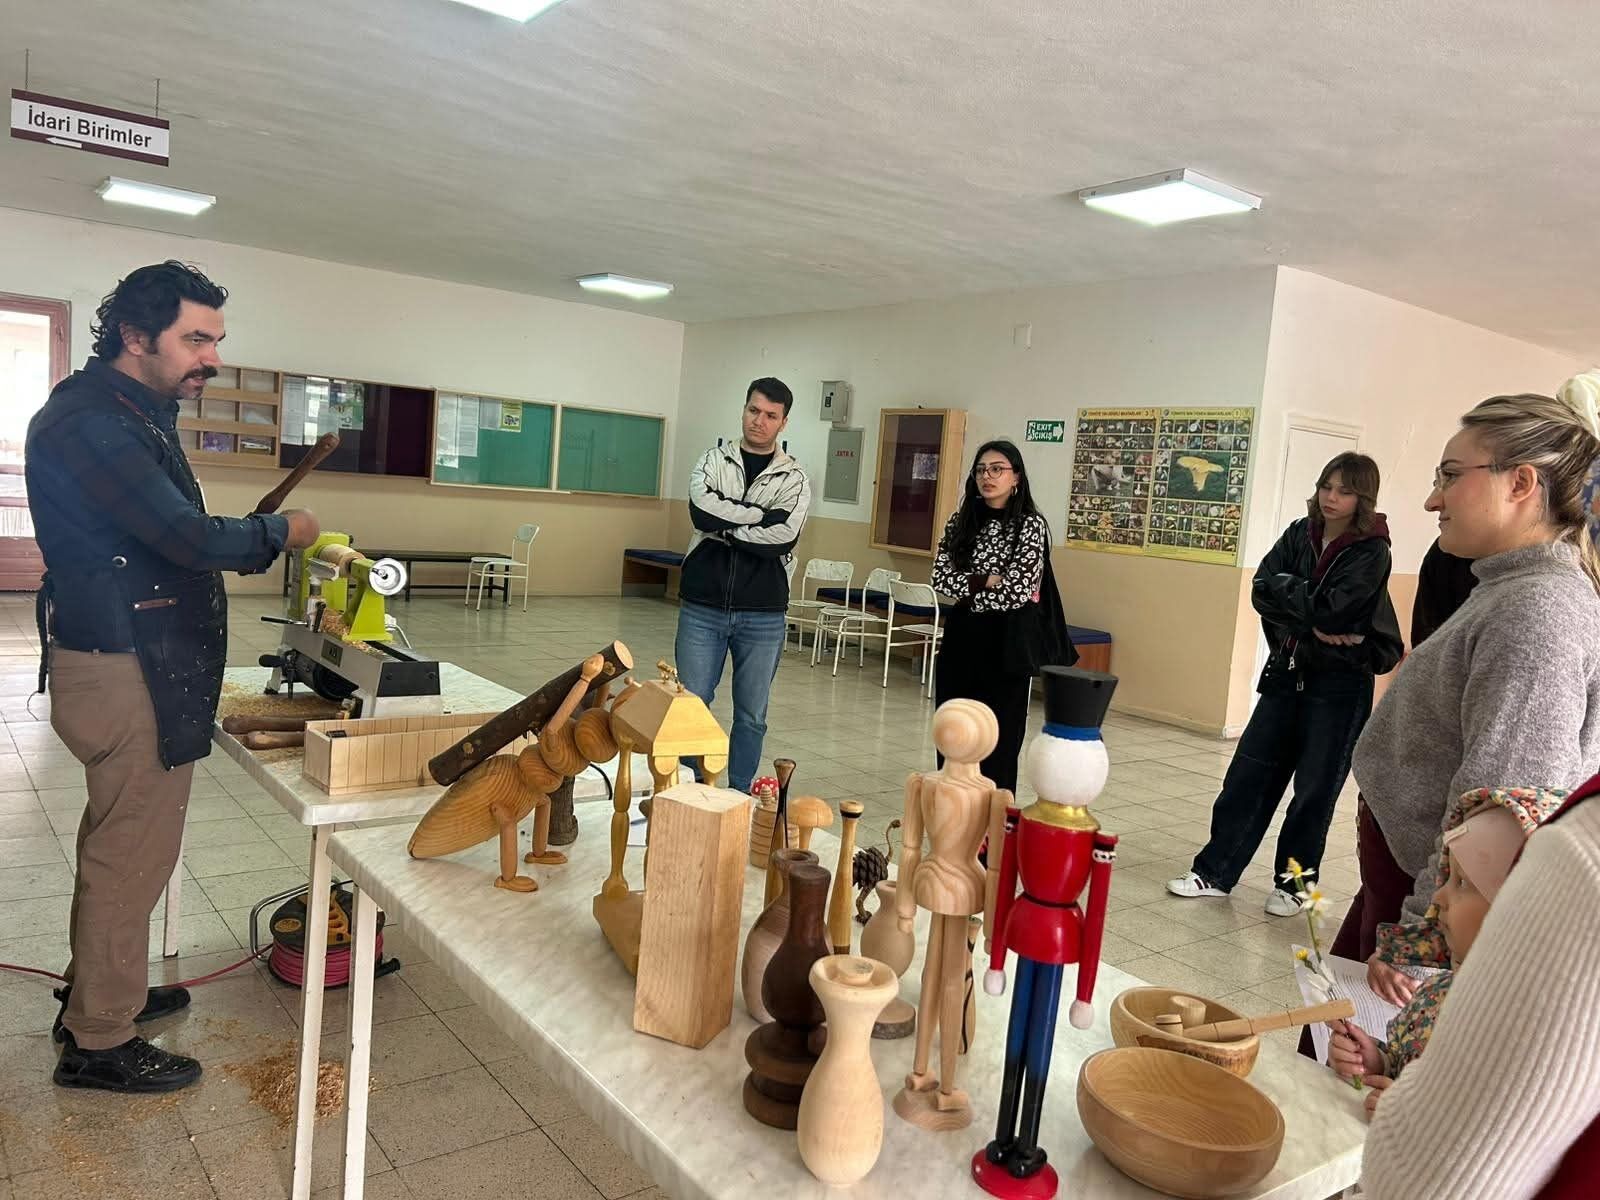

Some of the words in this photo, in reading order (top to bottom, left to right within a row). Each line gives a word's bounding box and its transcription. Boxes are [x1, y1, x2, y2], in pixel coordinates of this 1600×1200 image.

[28, 105, 71, 132] İdari
[77, 118, 152, 148] Birimler
[1036, 423, 1052, 431] EXIT
